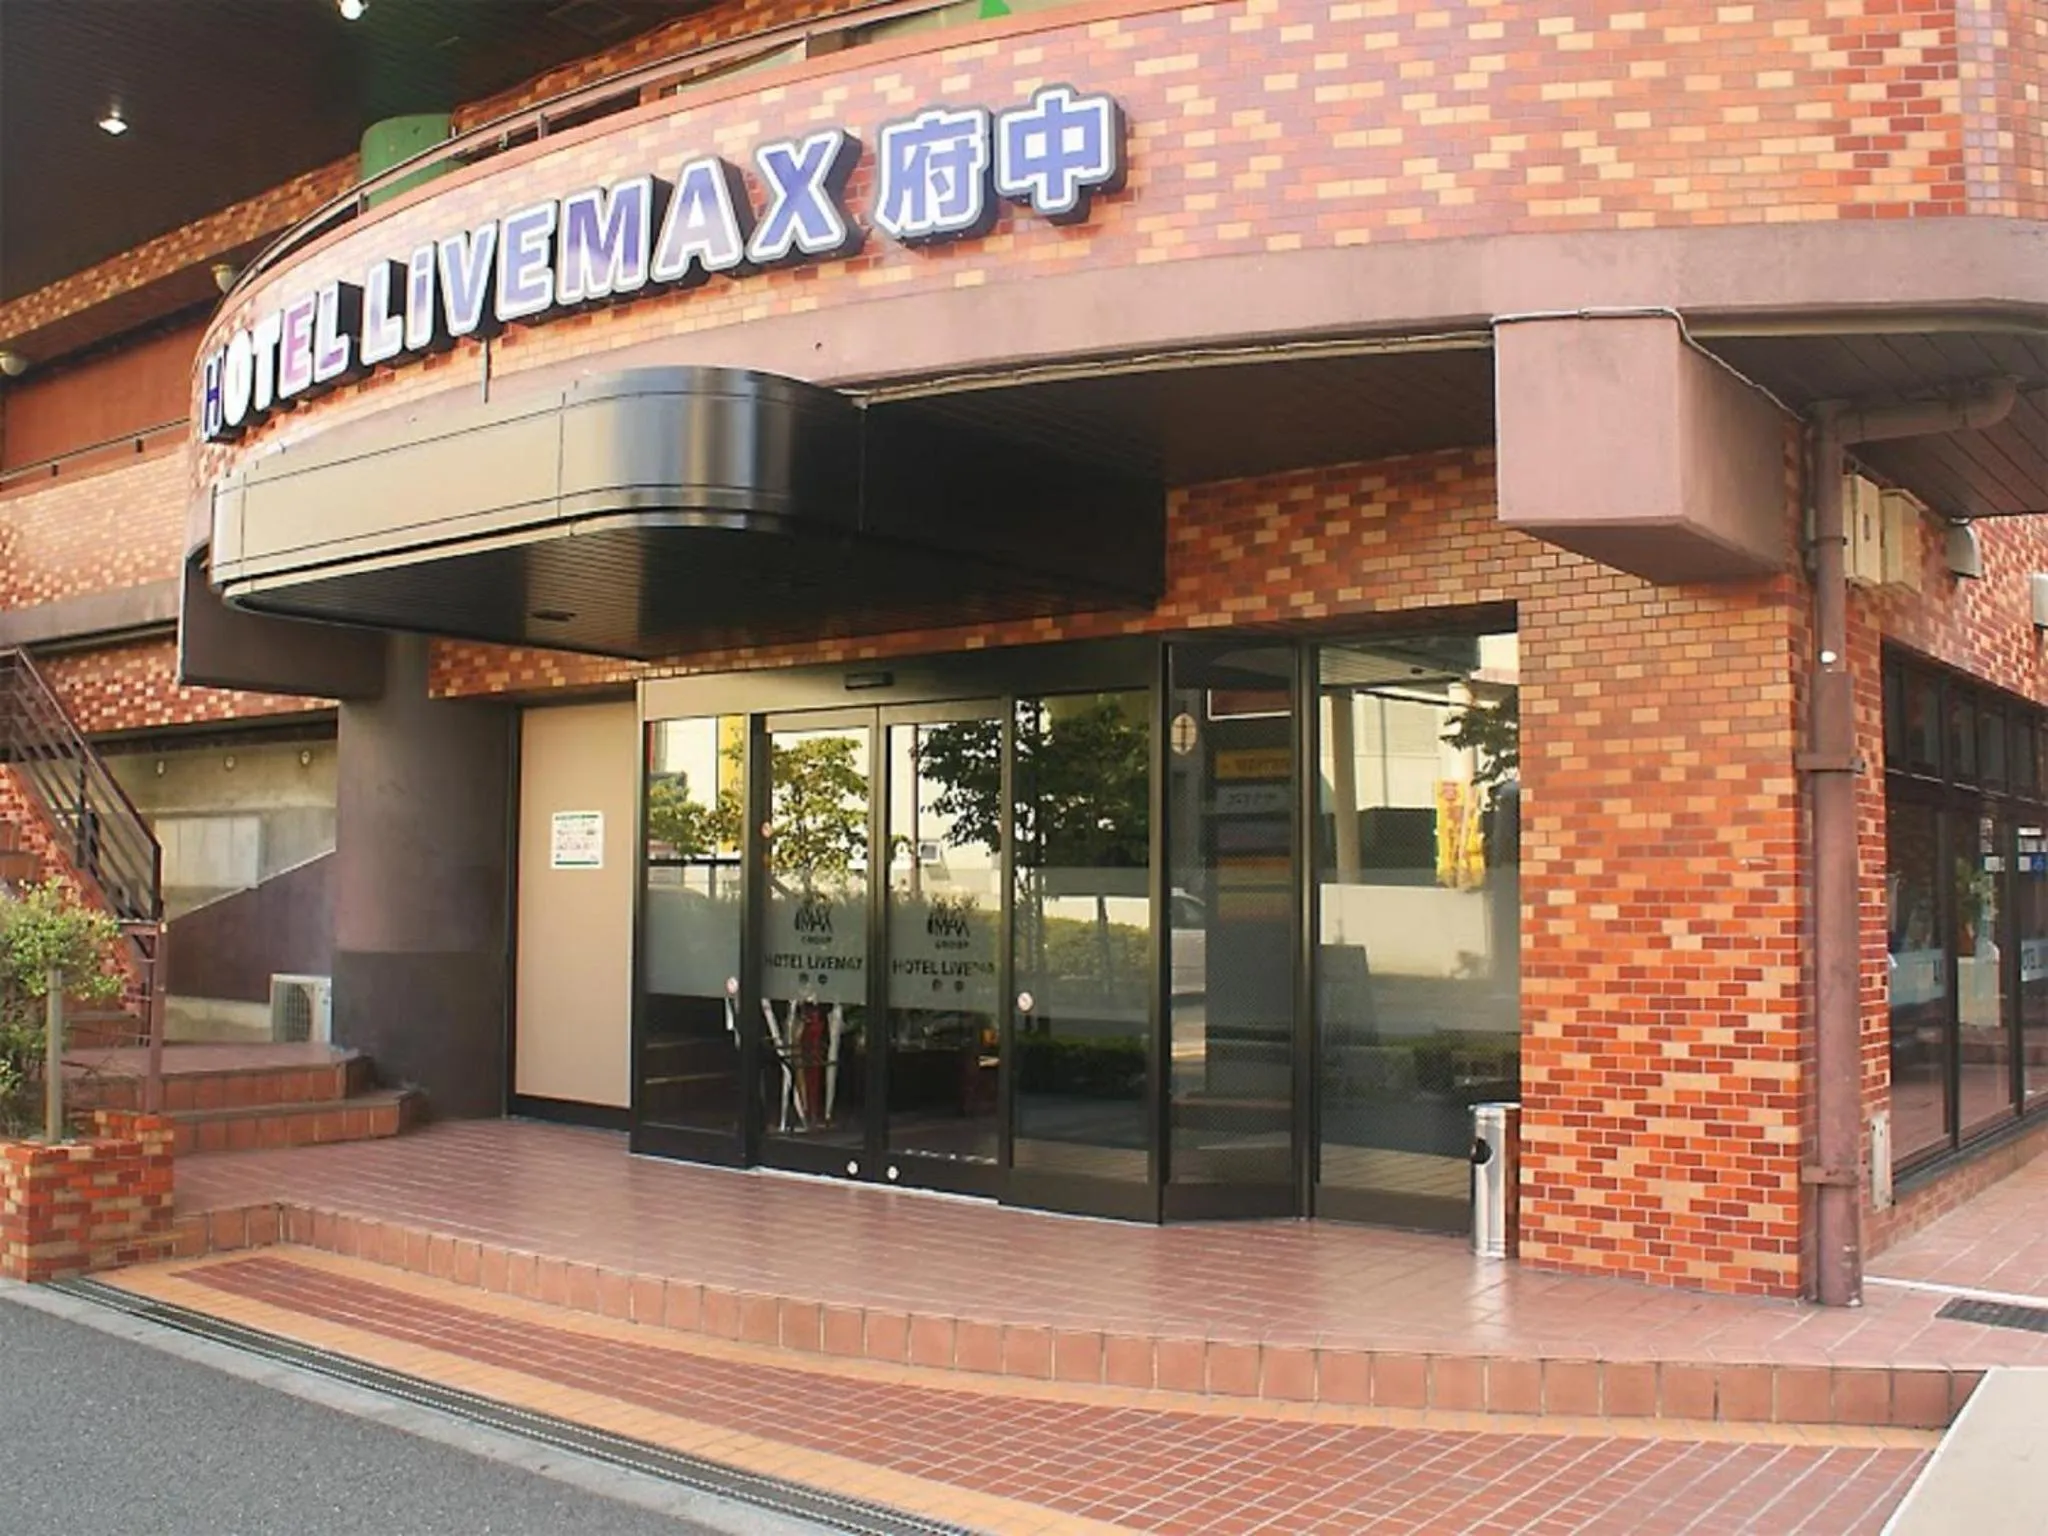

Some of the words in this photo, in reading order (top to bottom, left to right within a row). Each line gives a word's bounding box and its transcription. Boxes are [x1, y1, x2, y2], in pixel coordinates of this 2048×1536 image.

[202, 279, 352, 442] HOTEL
[872, 84, 1118, 240] 府中
[764, 953, 802, 969] HOTEL
[892, 959, 939, 976] HOTEL
